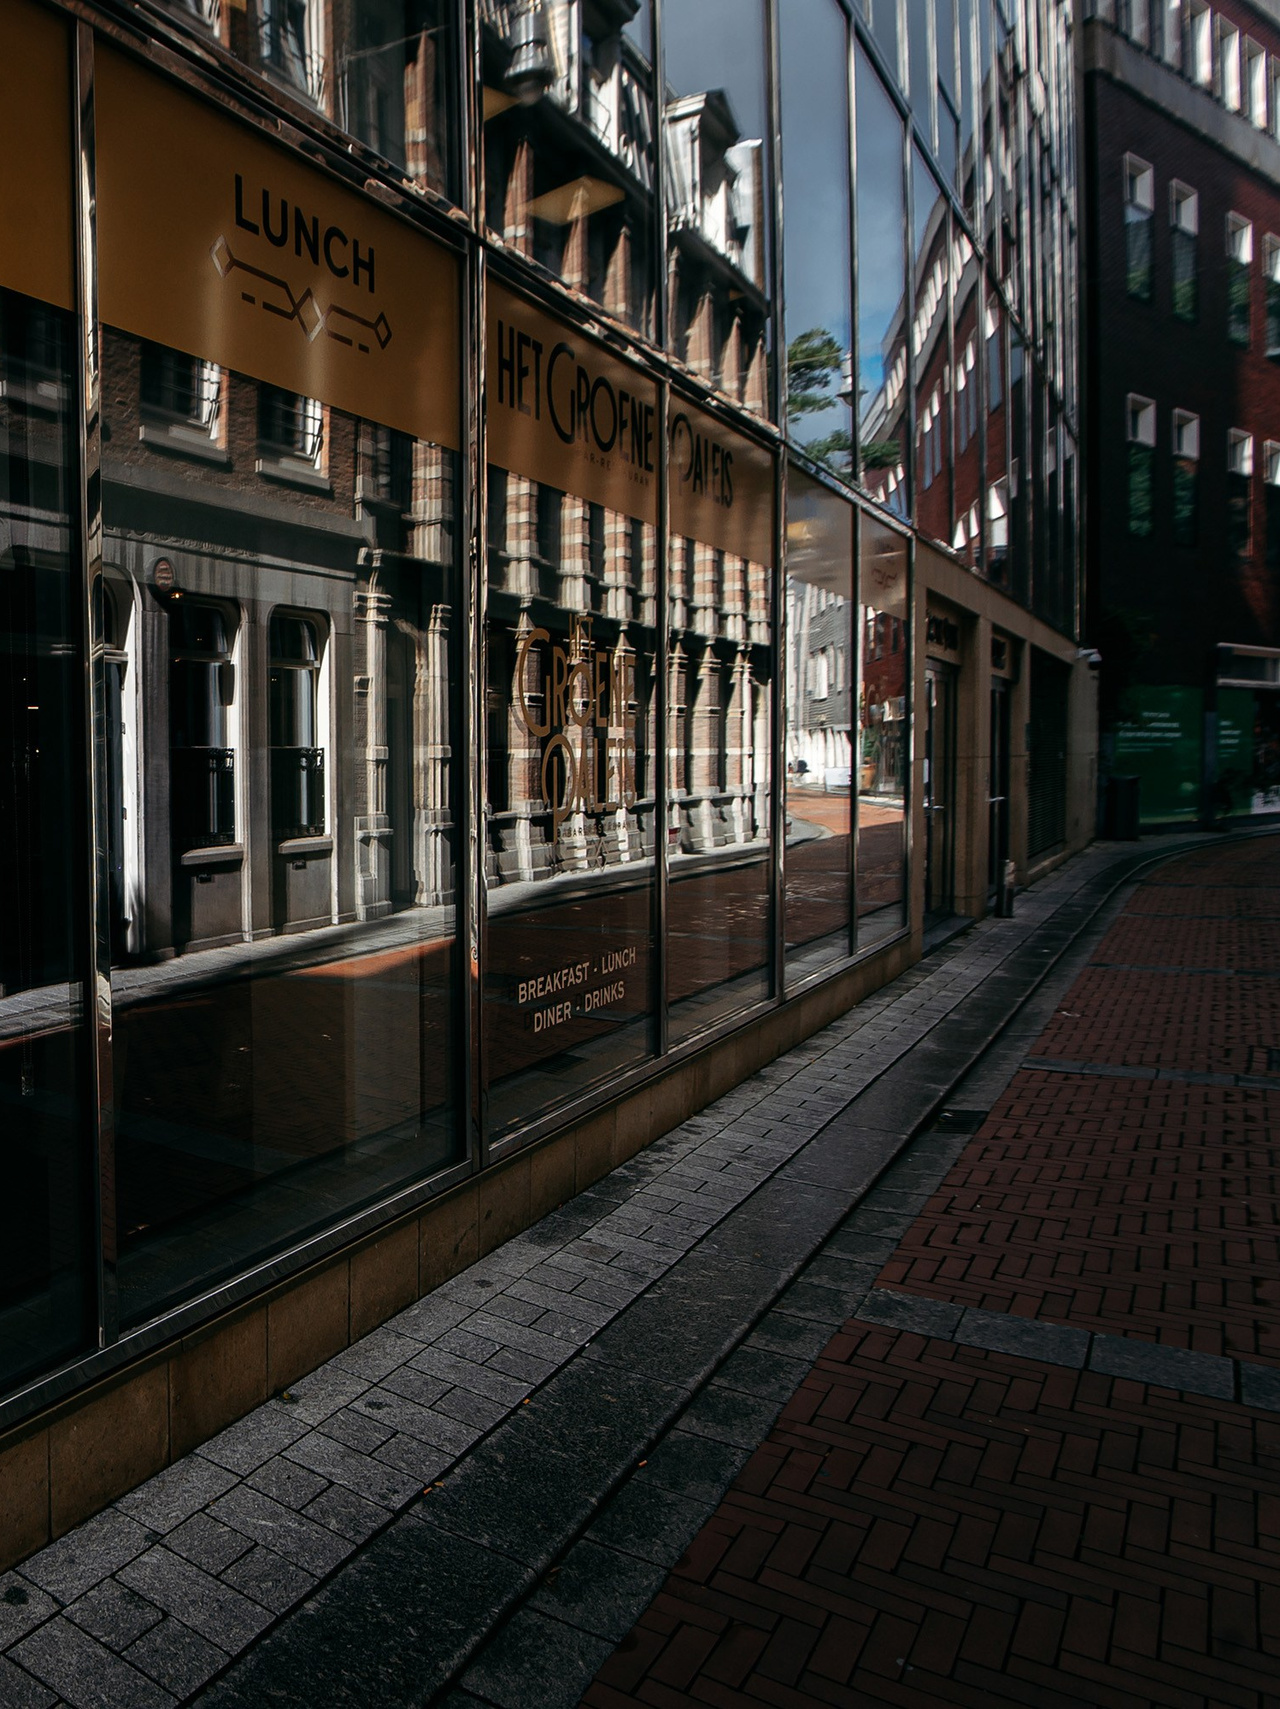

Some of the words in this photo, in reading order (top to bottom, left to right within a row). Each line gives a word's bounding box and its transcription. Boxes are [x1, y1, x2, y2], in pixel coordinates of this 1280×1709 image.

[234, 173, 376, 293] LUNCH
[498, 319, 543, 421] HET
[546, 341, 654, 474] GROENE
[518, 627, 636, 738] GROENE
[568, 612, 594, 662] HET
[541, 733, 637, 846] PALEIS
[518, 961, 590, 1004] BREAKFAST
[601, 946, 636, 975] LUNCH
[534, 1000, 572, 1033] DINER
[584, 980, 625, 1013] DRINKS
